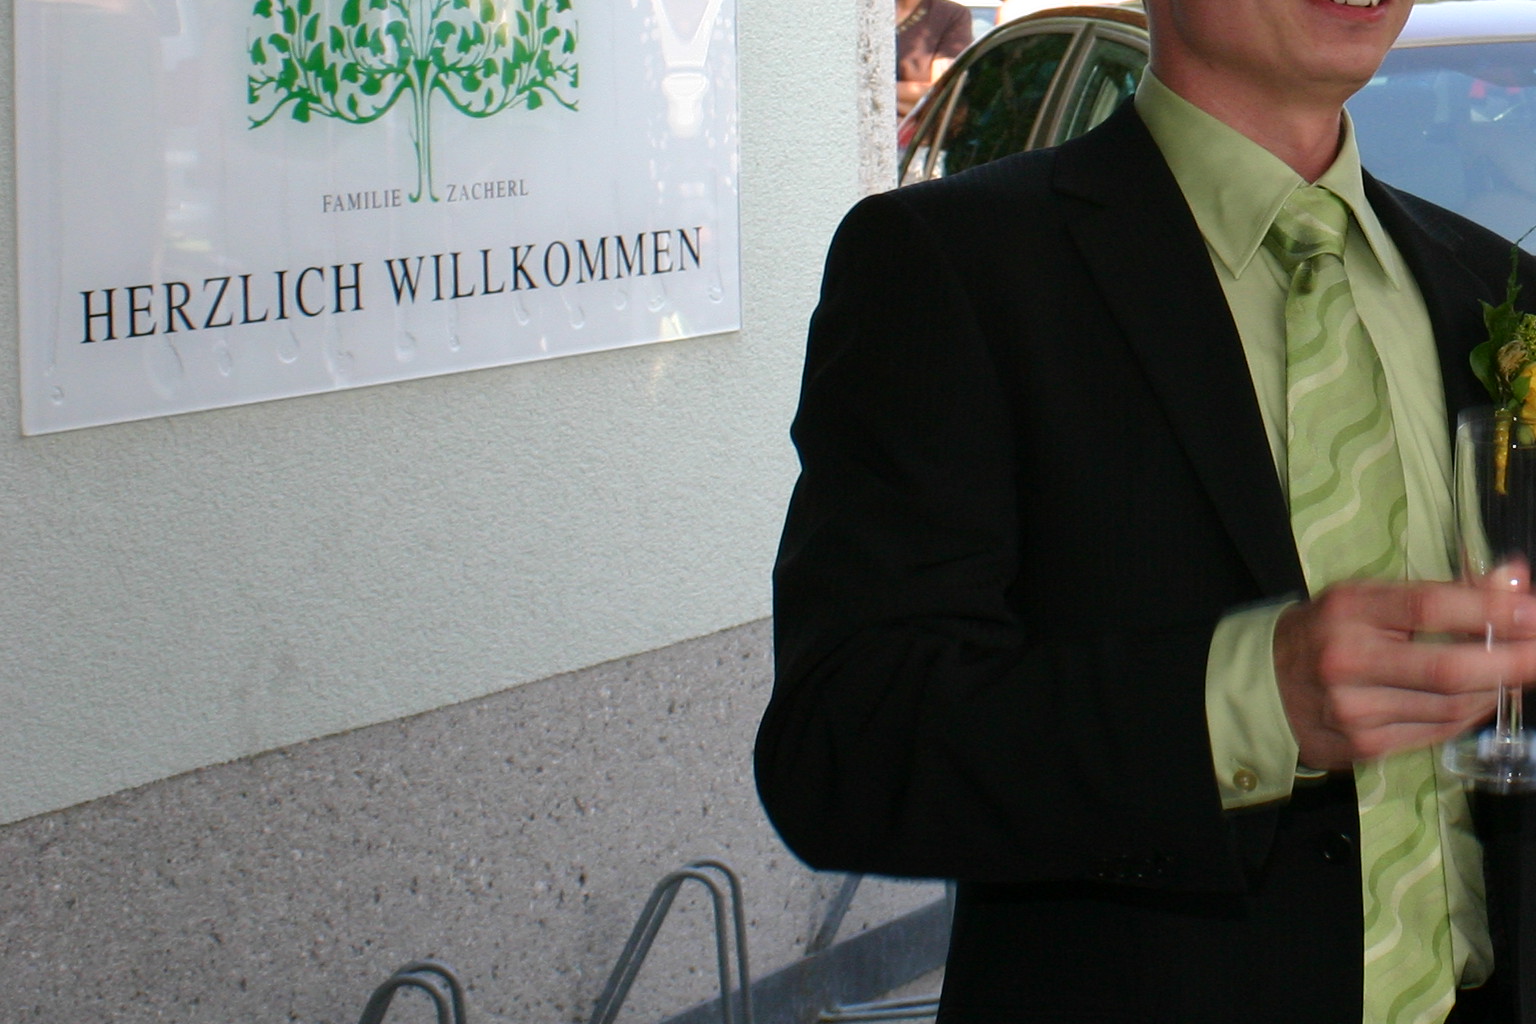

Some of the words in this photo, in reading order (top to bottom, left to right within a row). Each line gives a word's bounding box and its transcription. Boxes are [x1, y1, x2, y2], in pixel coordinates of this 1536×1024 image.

[321, 188, 402, 214] FAMILIE
[446, 179, 529, 203] ZACHERL
[79, 262, 365, 345] HERZLICH
[384, 226, 703, 306] WILLKOMMEN
